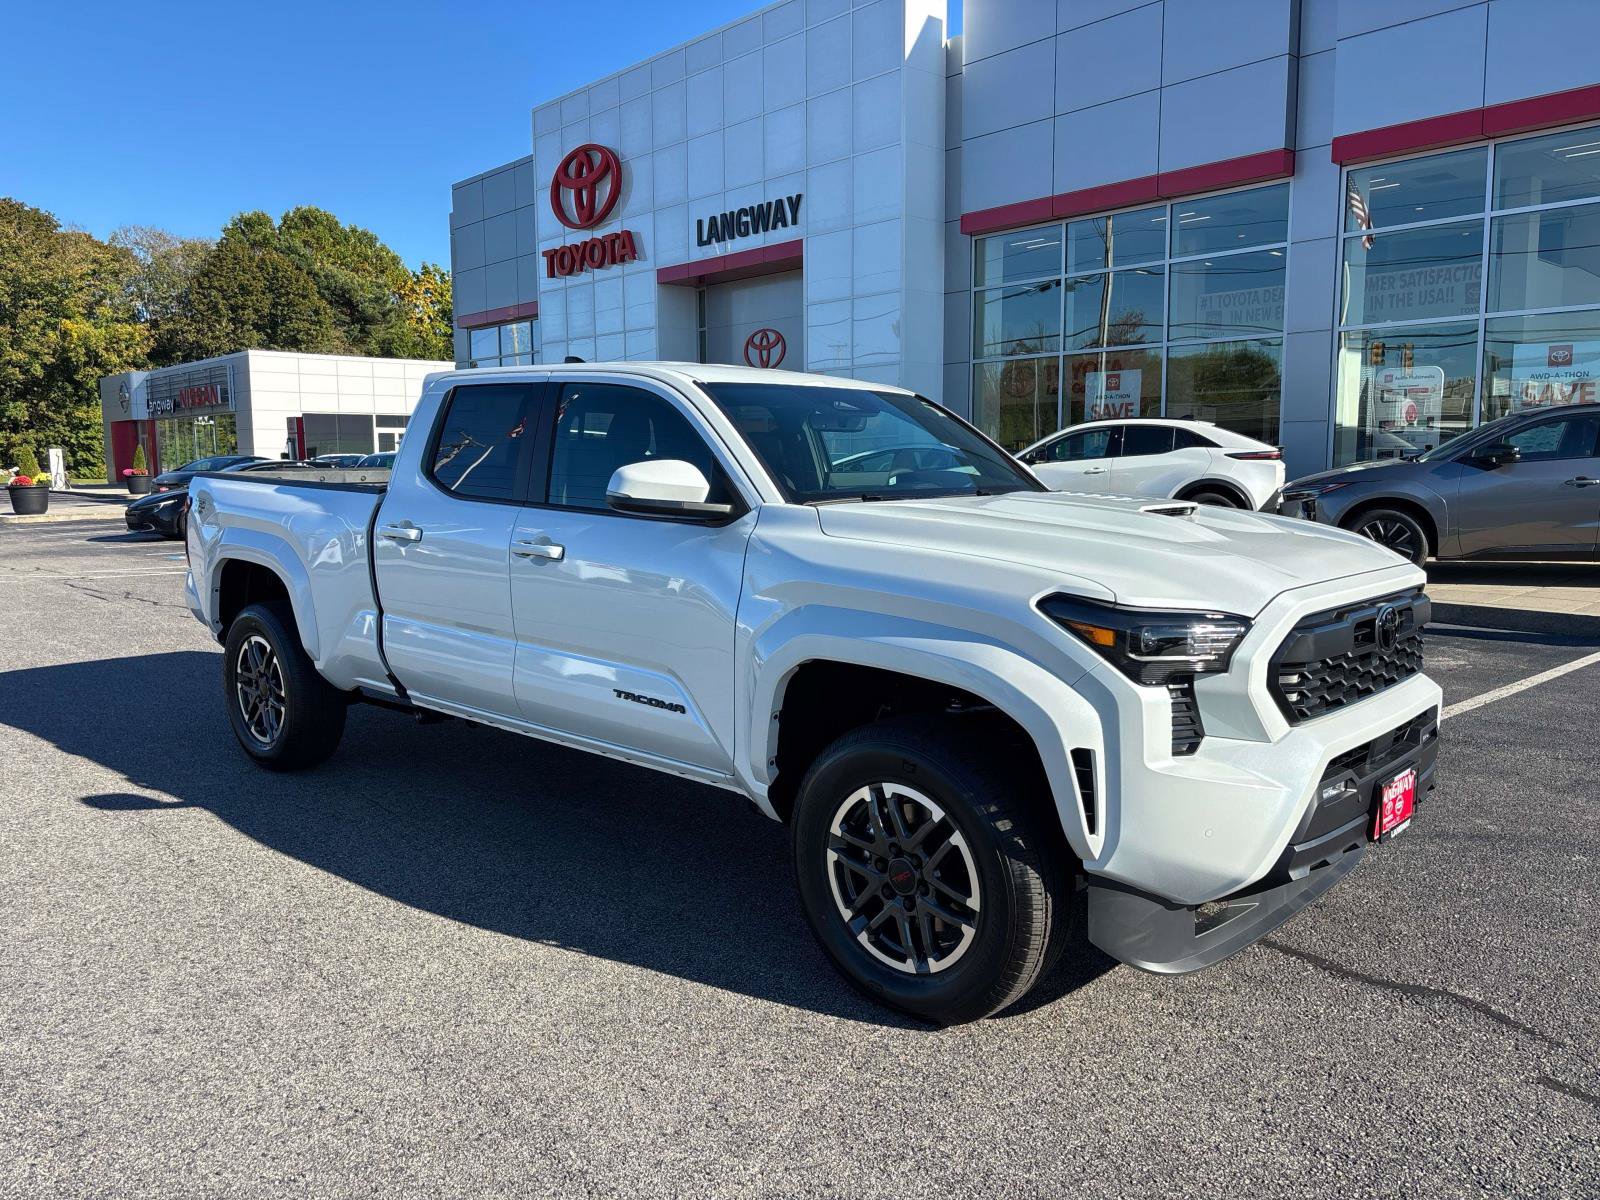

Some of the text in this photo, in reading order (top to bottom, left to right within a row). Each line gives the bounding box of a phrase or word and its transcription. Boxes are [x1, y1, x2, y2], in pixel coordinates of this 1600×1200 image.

[697, 194, 802, 247] LANGWAY
[542, 230, 637, 278] TOYOTA
[1217, 290, 1259, 309] TOYOTA
[1369, 286, 1455, 312] IN THE USA!!
[1230, 310, 1242, 324] IN
[1246, 305, 1271, 322] NEW
[1530, 371, 1590, 380] AWD-A-THON
[146, 384, 221, 414] Langway NISSAN
[1090, 402, 1135, 420] SAVE
[612, 688, 686, 714] TACOMA
[1383, 774, 1415, 804] ANGWAY
